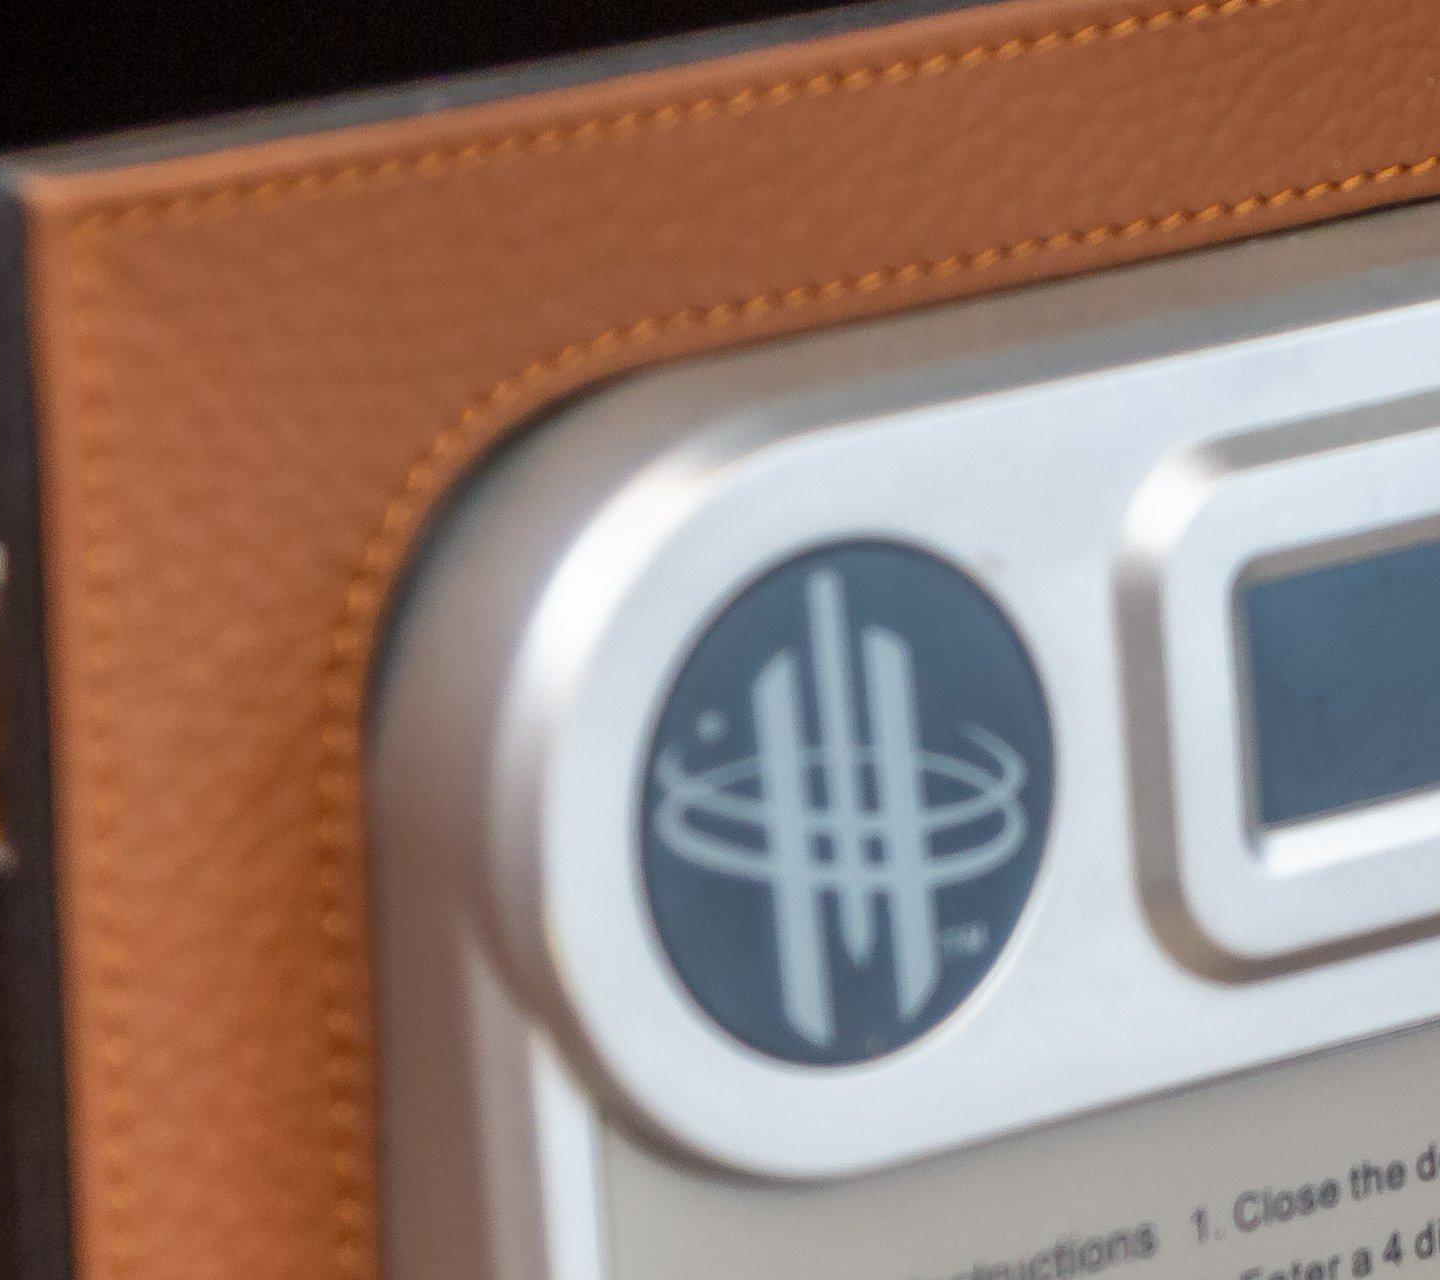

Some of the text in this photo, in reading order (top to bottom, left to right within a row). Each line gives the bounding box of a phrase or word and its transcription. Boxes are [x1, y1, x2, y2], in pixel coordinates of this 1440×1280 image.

[1190, 1204, 1225, 1244] 1.
[1232, 1185, 1341, 1233] Close
[1348, 1159, 1408, 1201] the
[1351, 1246, 1373, 1278] a
[1383, 1230, 1402, 1266] 4
